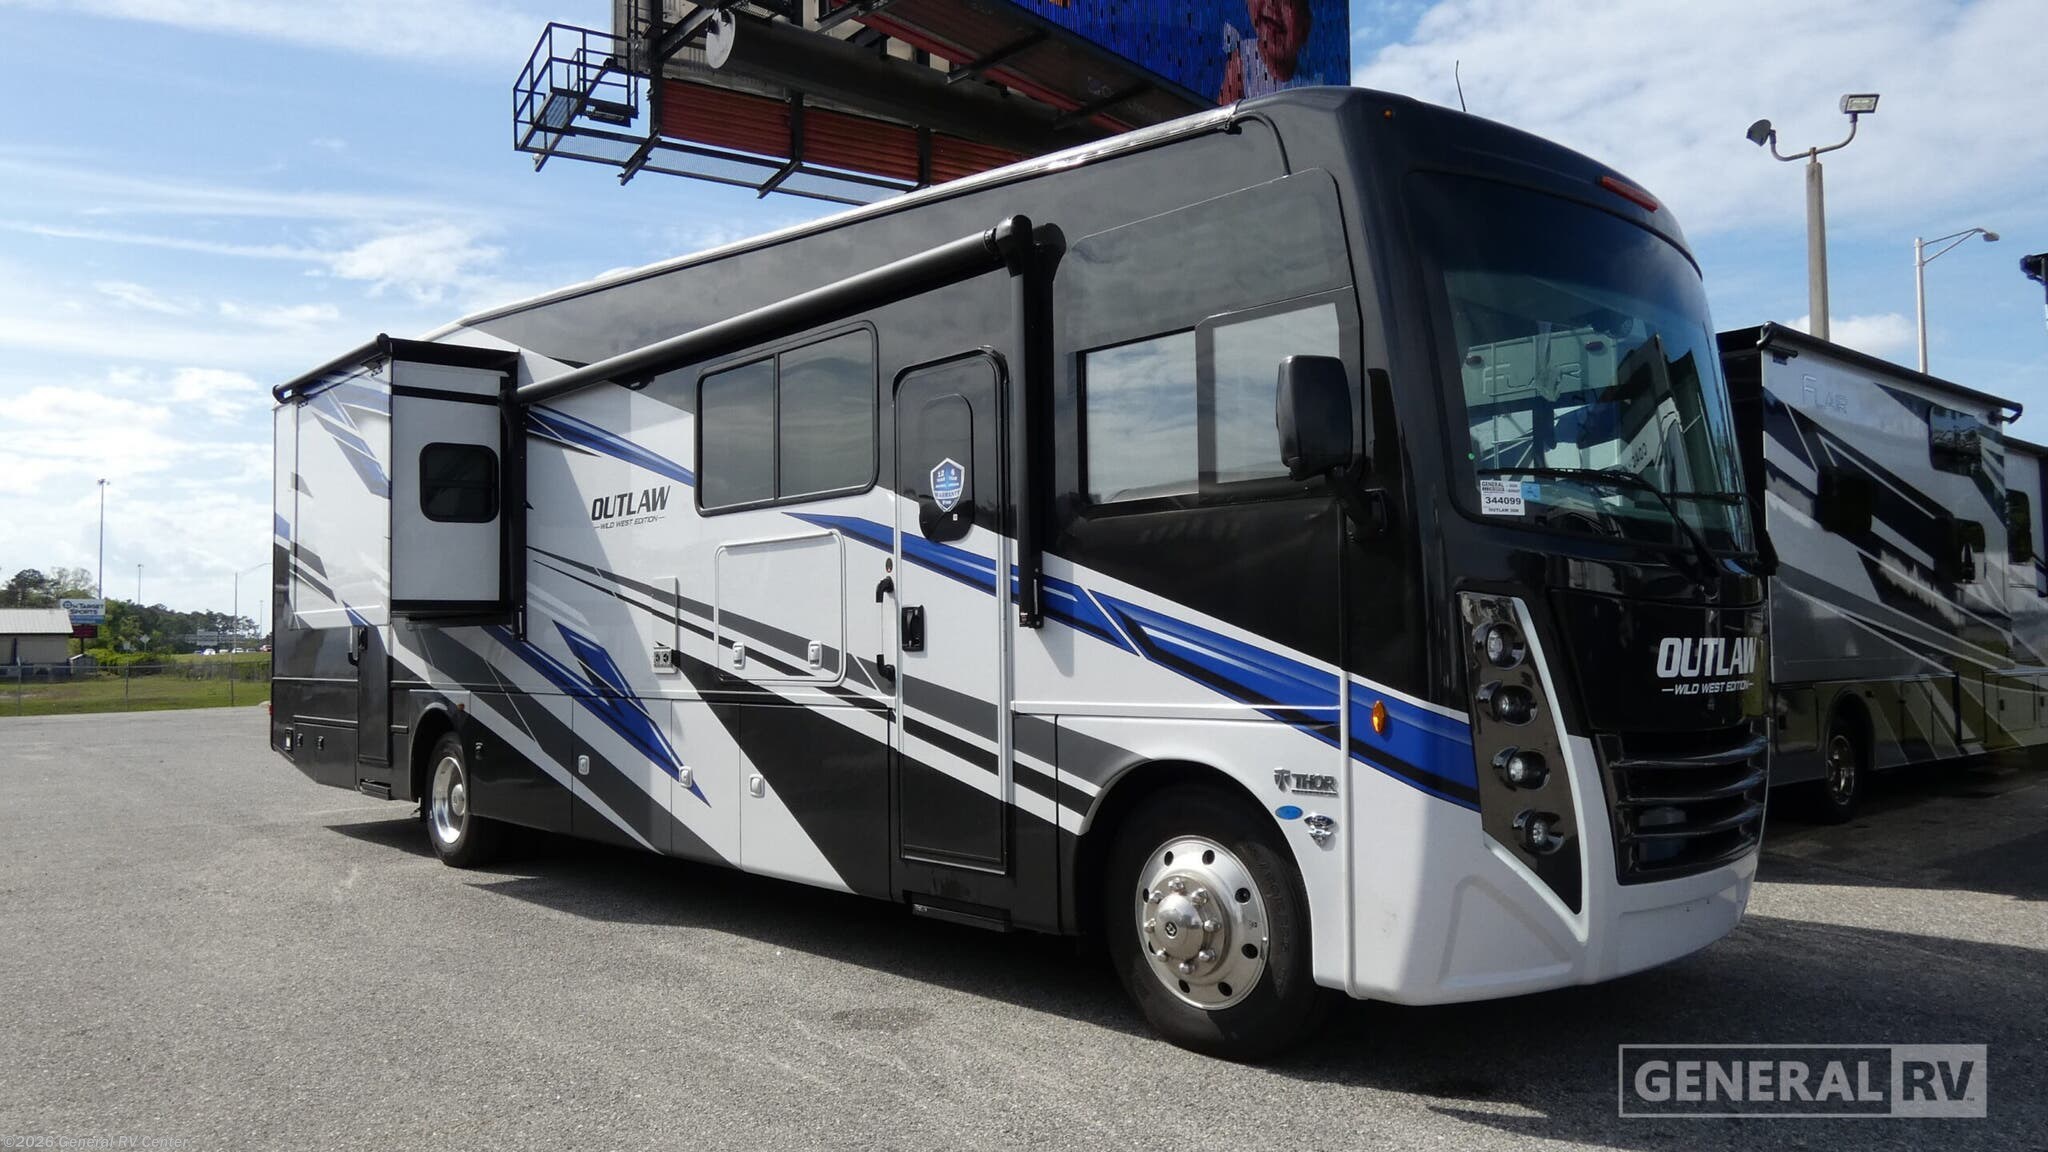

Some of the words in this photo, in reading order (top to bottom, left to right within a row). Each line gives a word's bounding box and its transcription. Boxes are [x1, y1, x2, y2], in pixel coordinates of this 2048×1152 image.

[591, 485, 671, 521] OUTLAW
[1485, 496, 1522, 505] 344099
[600, 521, 615, 530] WILD
[616, 519, 633, 528] WEST
[634, 515, 658, 525] EDITION
[1656, 637, 1758, 678] OUTLAW
[1674, 683, 1700, 695] WILD
[1701, 681, 1726, 694] WEST
[1726, 680, 1749, 692] EDITION
[1291, 773, 1335, 792] THOR
